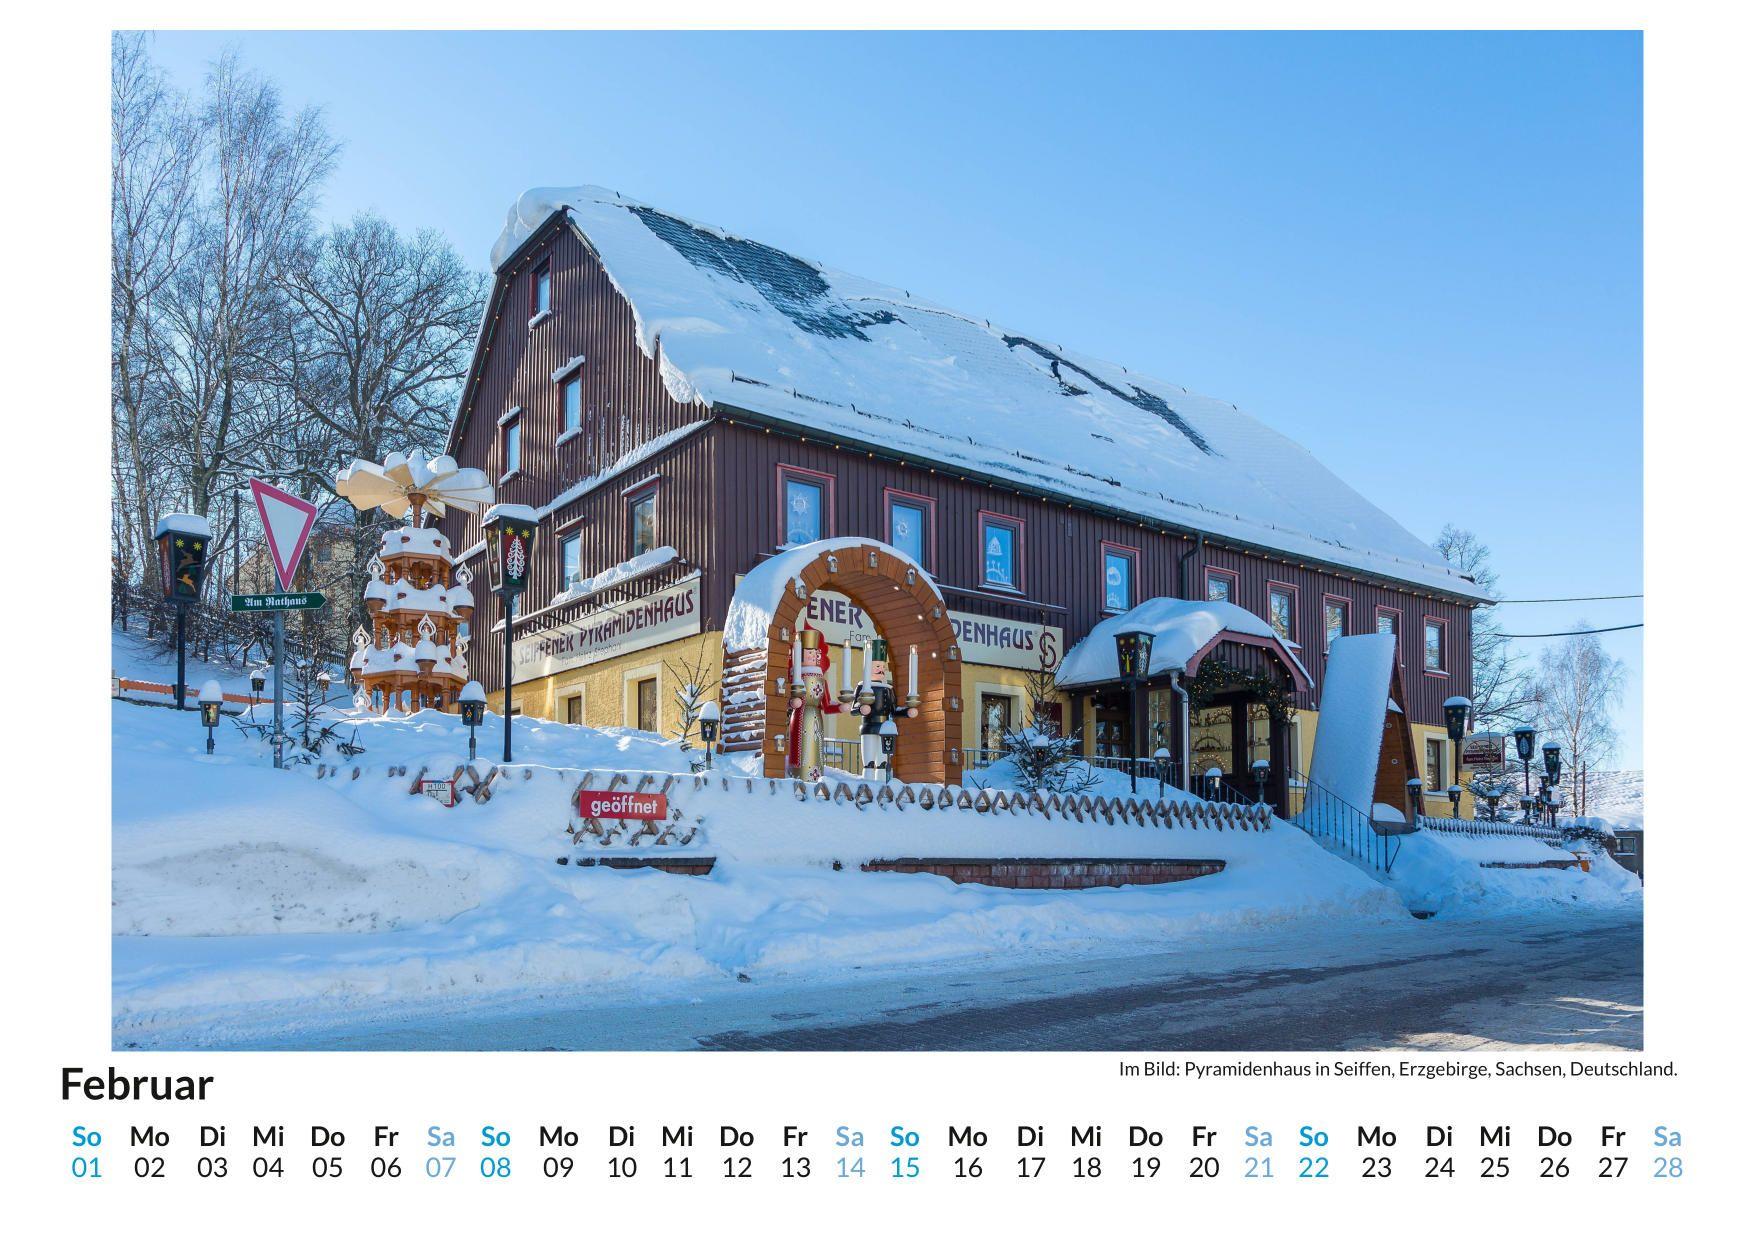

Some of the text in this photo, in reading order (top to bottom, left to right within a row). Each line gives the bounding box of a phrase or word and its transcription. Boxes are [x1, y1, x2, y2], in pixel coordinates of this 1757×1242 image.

[244, 595, 308, 609] Am Rathaus
[519, 632, 574, 666] SEIFFENER
[579, 589, 695, 648] PYRAMIDENHAUS
[590, 794, 658, 817] geöffnet
